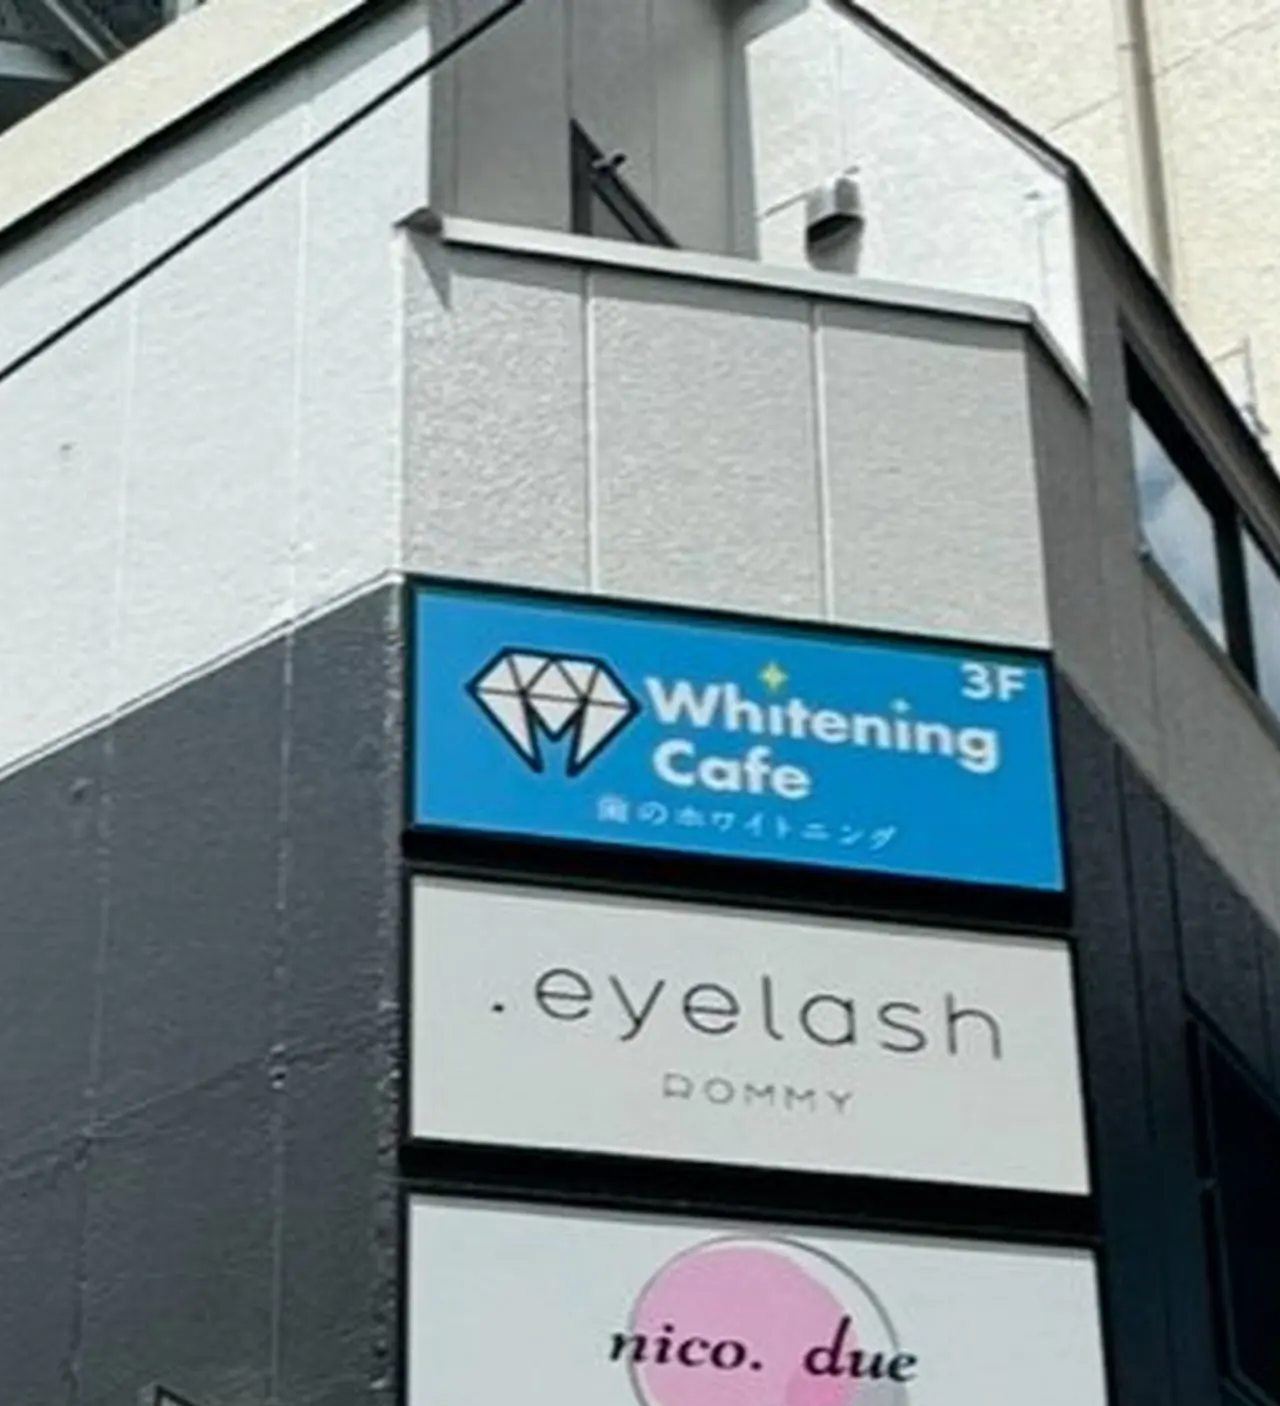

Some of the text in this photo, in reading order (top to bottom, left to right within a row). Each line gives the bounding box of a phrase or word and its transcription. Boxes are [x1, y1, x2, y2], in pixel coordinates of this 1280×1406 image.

[960, 661, 1025, 701] 3F
[645, 672, 1001, 772] Whitening
[653, 737, 811, 801] Cafe
[662, 1072, 854, 1115] ROMMY
[609, 1314, 919, 1383] nico. due
